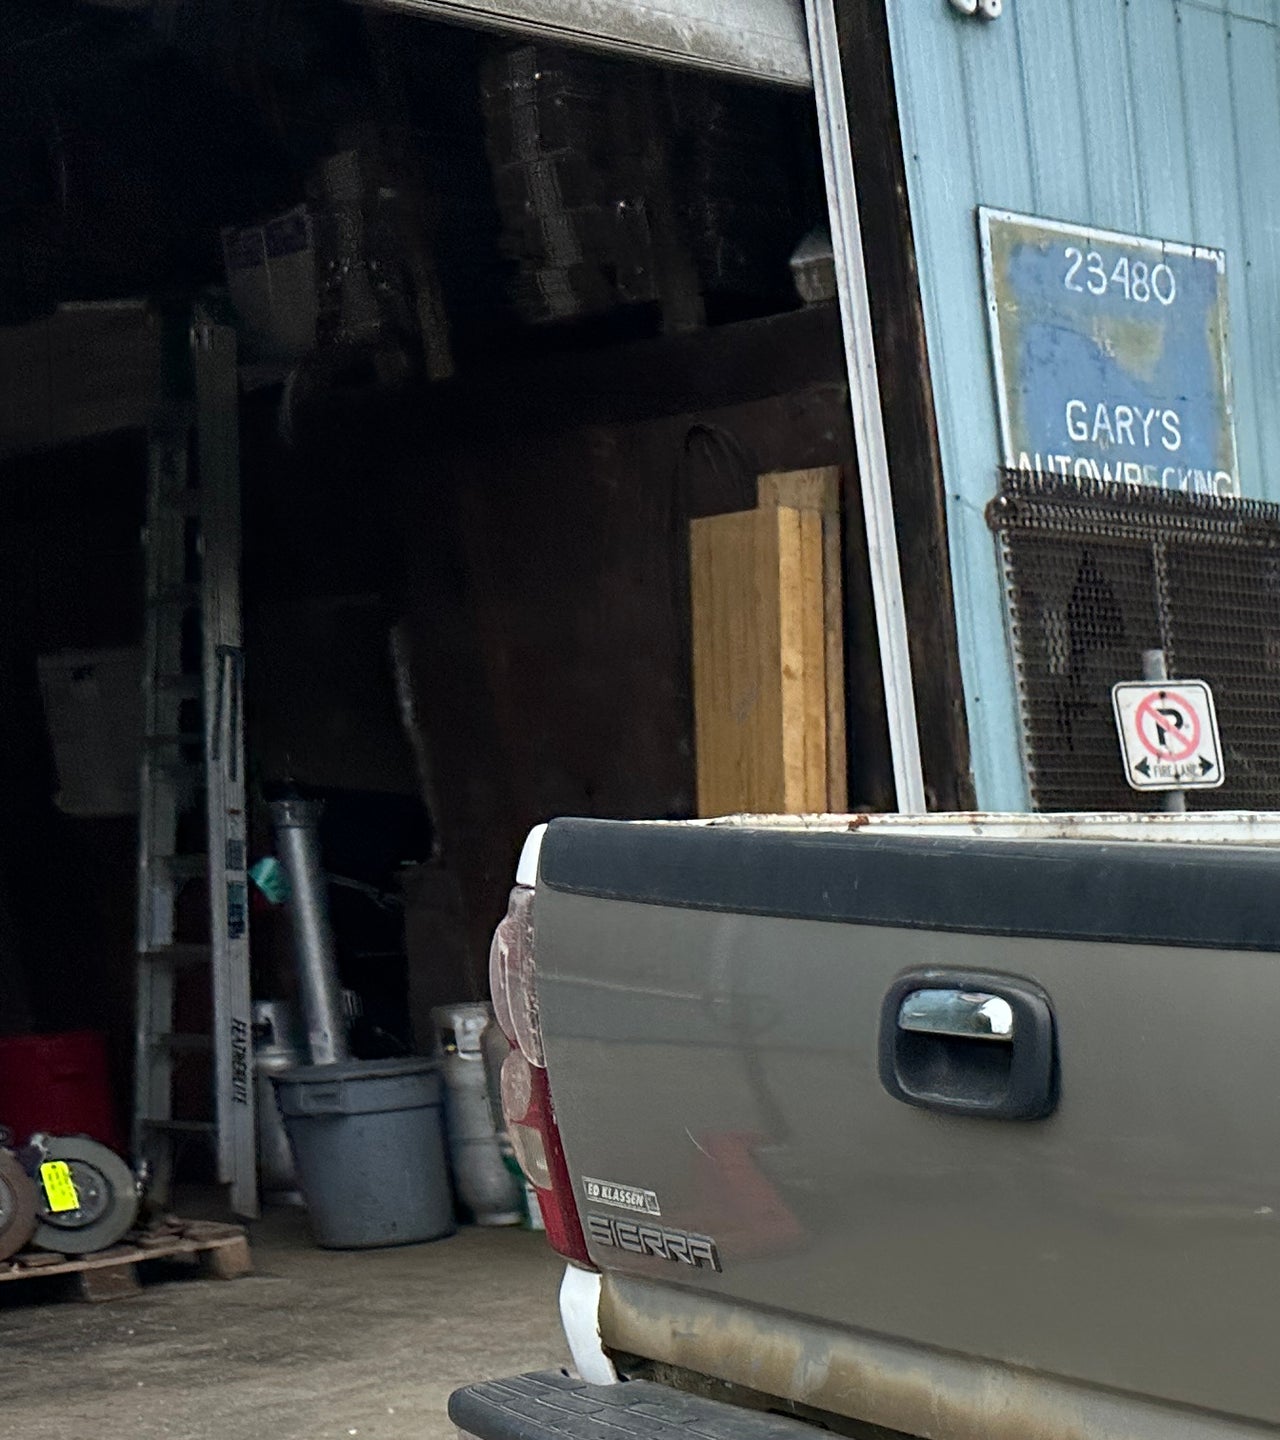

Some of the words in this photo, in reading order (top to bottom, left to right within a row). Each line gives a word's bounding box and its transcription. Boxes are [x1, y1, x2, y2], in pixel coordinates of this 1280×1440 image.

[1064, 246, 1176, 305] 23480
[1065, 399, 1181, 451] GARY'S
[587, 1183, 600, 1196] ED
[601, 1186, 645, 1207] KLASSEN
[586, 1214, 722, 1272] SIERRA
